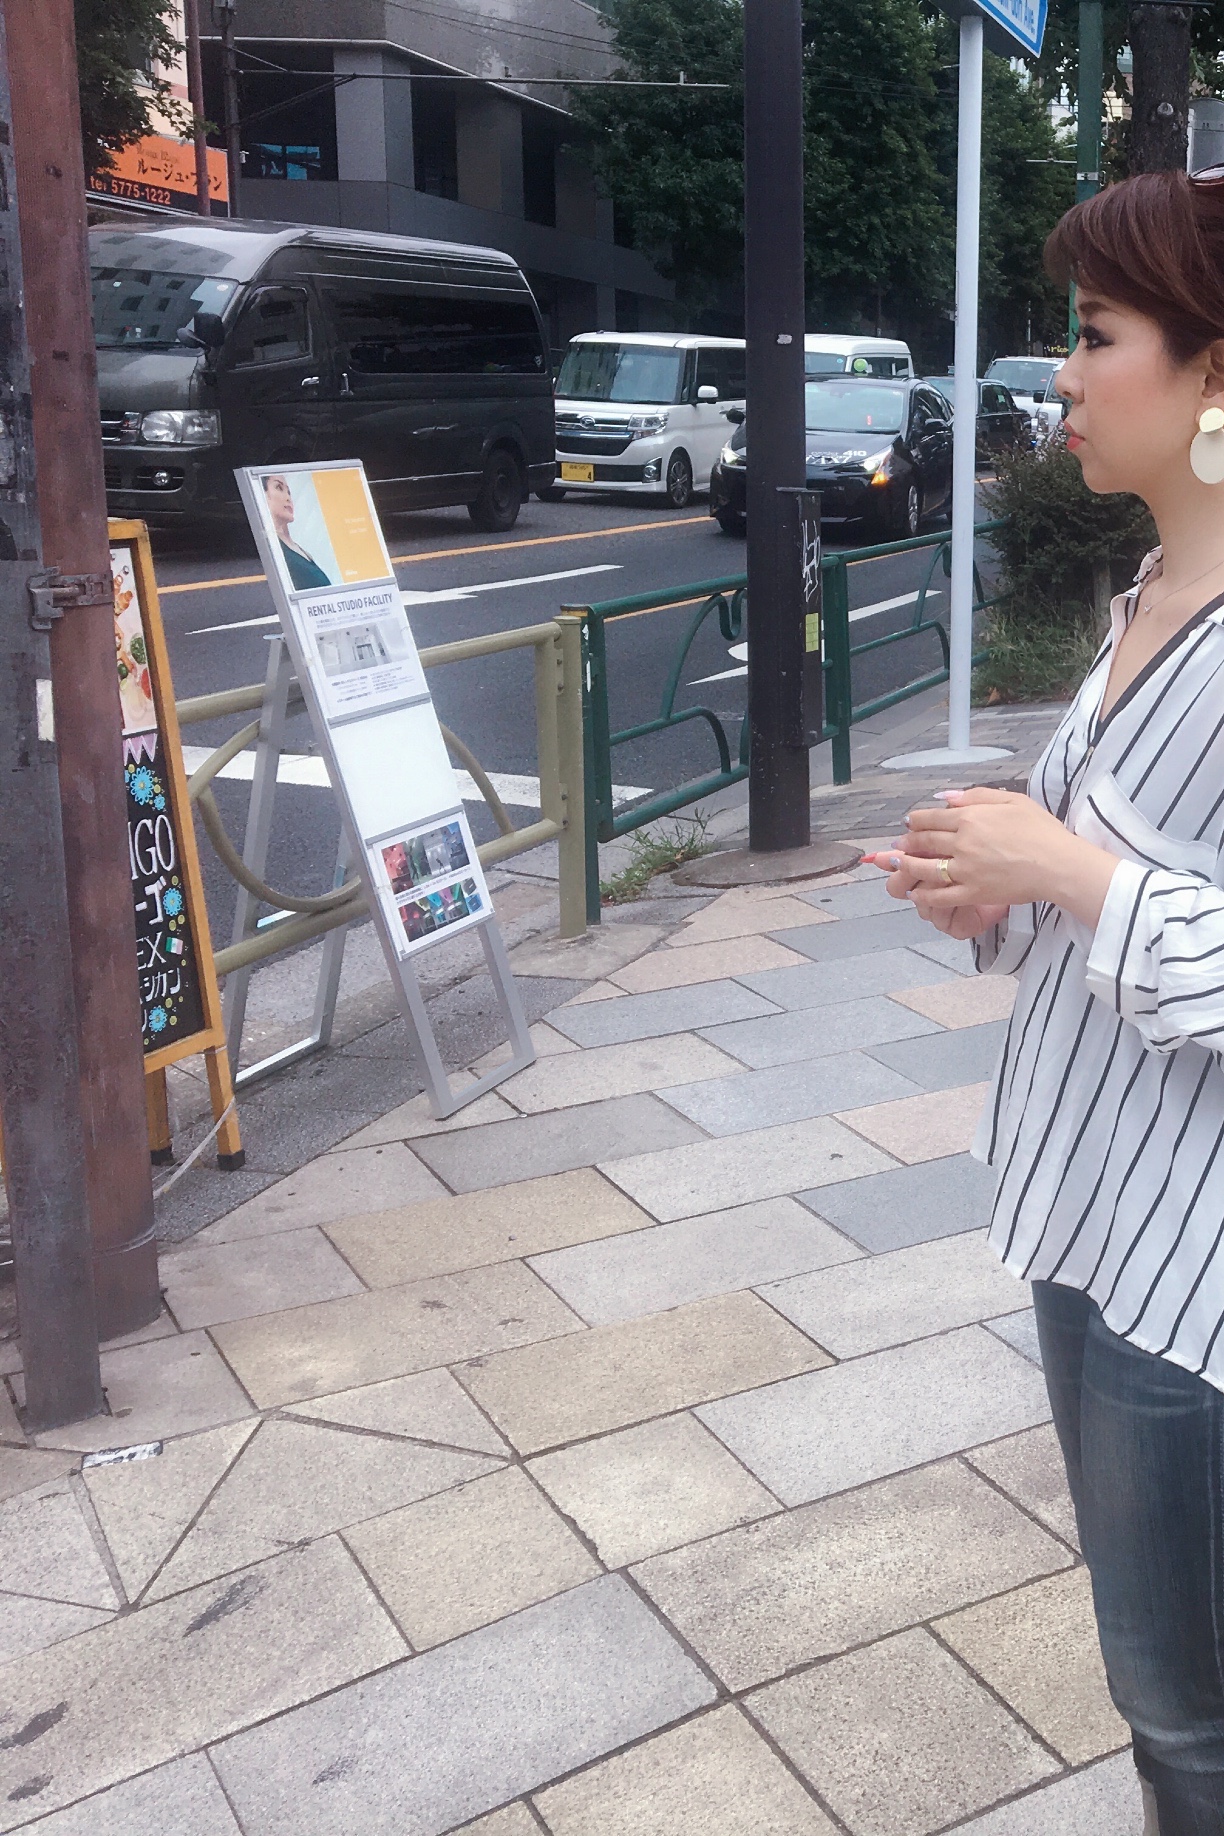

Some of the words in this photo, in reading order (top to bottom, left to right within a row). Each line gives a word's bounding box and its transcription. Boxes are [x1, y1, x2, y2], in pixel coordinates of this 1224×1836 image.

[137, 158, 222, 191] ルージュ・ン
[111, 179, 171, 205] 5775-1222
[307, 603, 337, 617] RENTAL
[337, 598, 363, 612] STUDIO
[363, 593, 393, 607] FACILITY
[139, 967, 181, 1005] シカン
